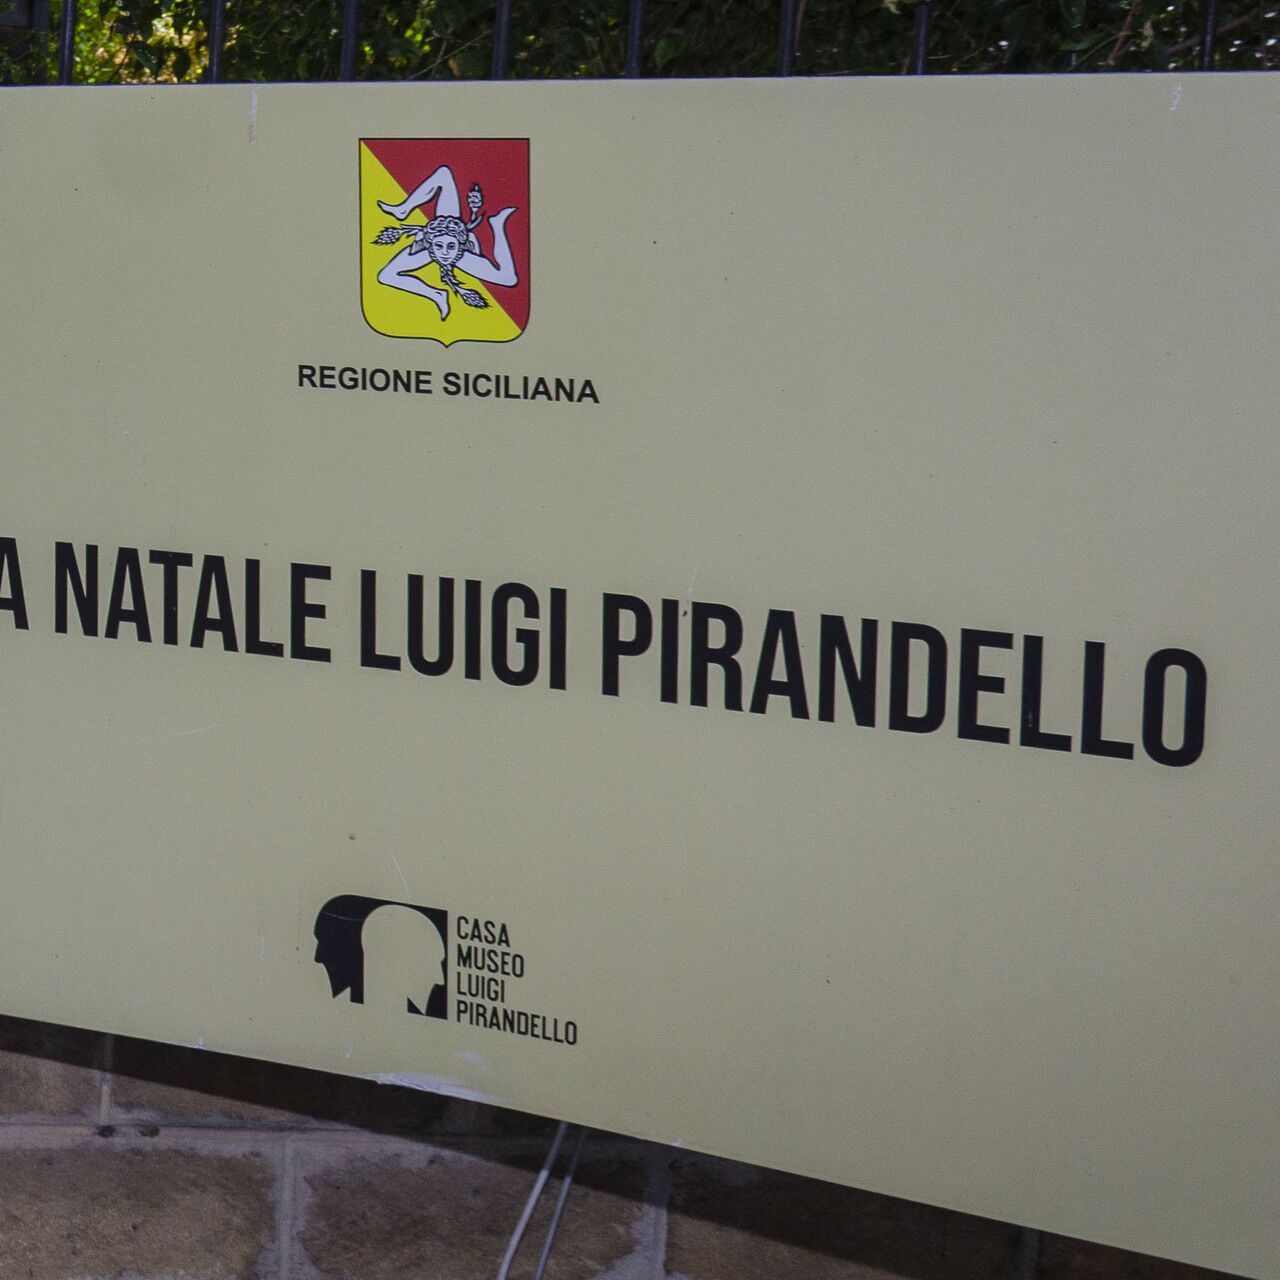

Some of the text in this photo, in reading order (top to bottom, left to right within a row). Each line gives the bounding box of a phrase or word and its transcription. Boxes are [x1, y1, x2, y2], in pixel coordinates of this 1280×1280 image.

[298, 364, 601, 404] REGIONE SICILIANA
[54, 541, 332, 664] NATALE
[360, 568, 568, 691] LUIGI
[601, 592, 1208, 768] PIRANDELLO
[456, 915, 511, 948] CASA
[456, 943, 525, 979] MUSEO
[456, 971, 505, 1004] LUIGI
[456, 999, 578, 1046] PIRANDELLO
